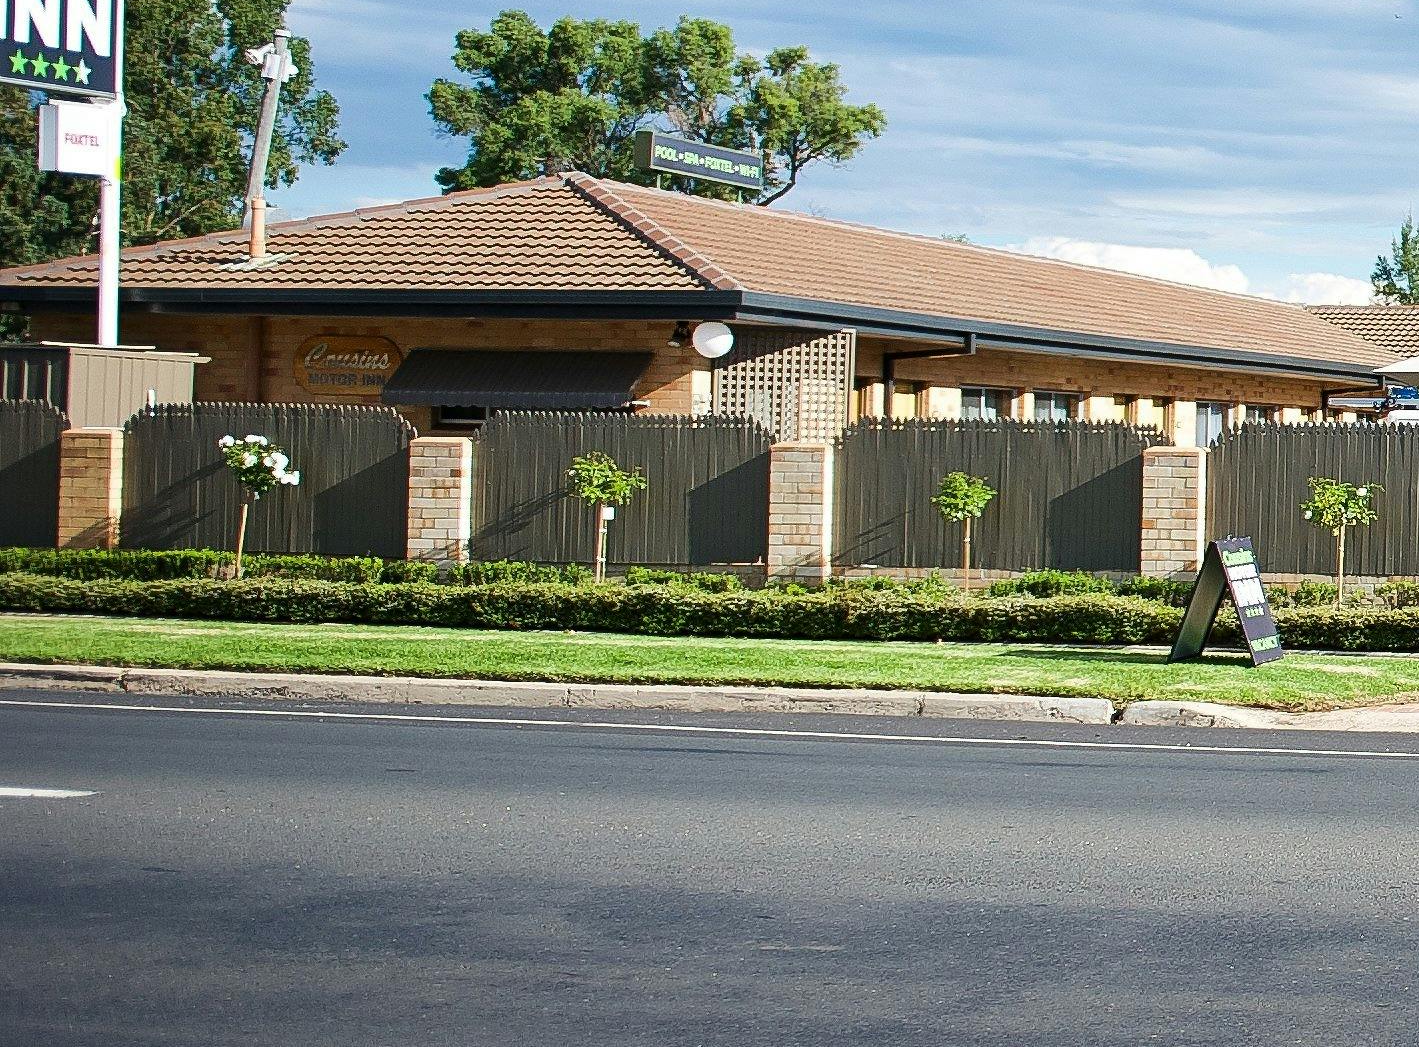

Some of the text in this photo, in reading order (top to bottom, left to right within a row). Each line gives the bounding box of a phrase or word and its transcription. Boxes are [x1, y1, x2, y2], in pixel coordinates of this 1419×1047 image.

[65, 132, 99, 146] FOXTEL
[655, 145, 678, 161] POOL
[683, 151, 700, 166] SPA
[705, 156, 734, 173] FOXTEL
[304, 343, 391, 369] Cousins
[308, 373, 357, 386] MOTOR
